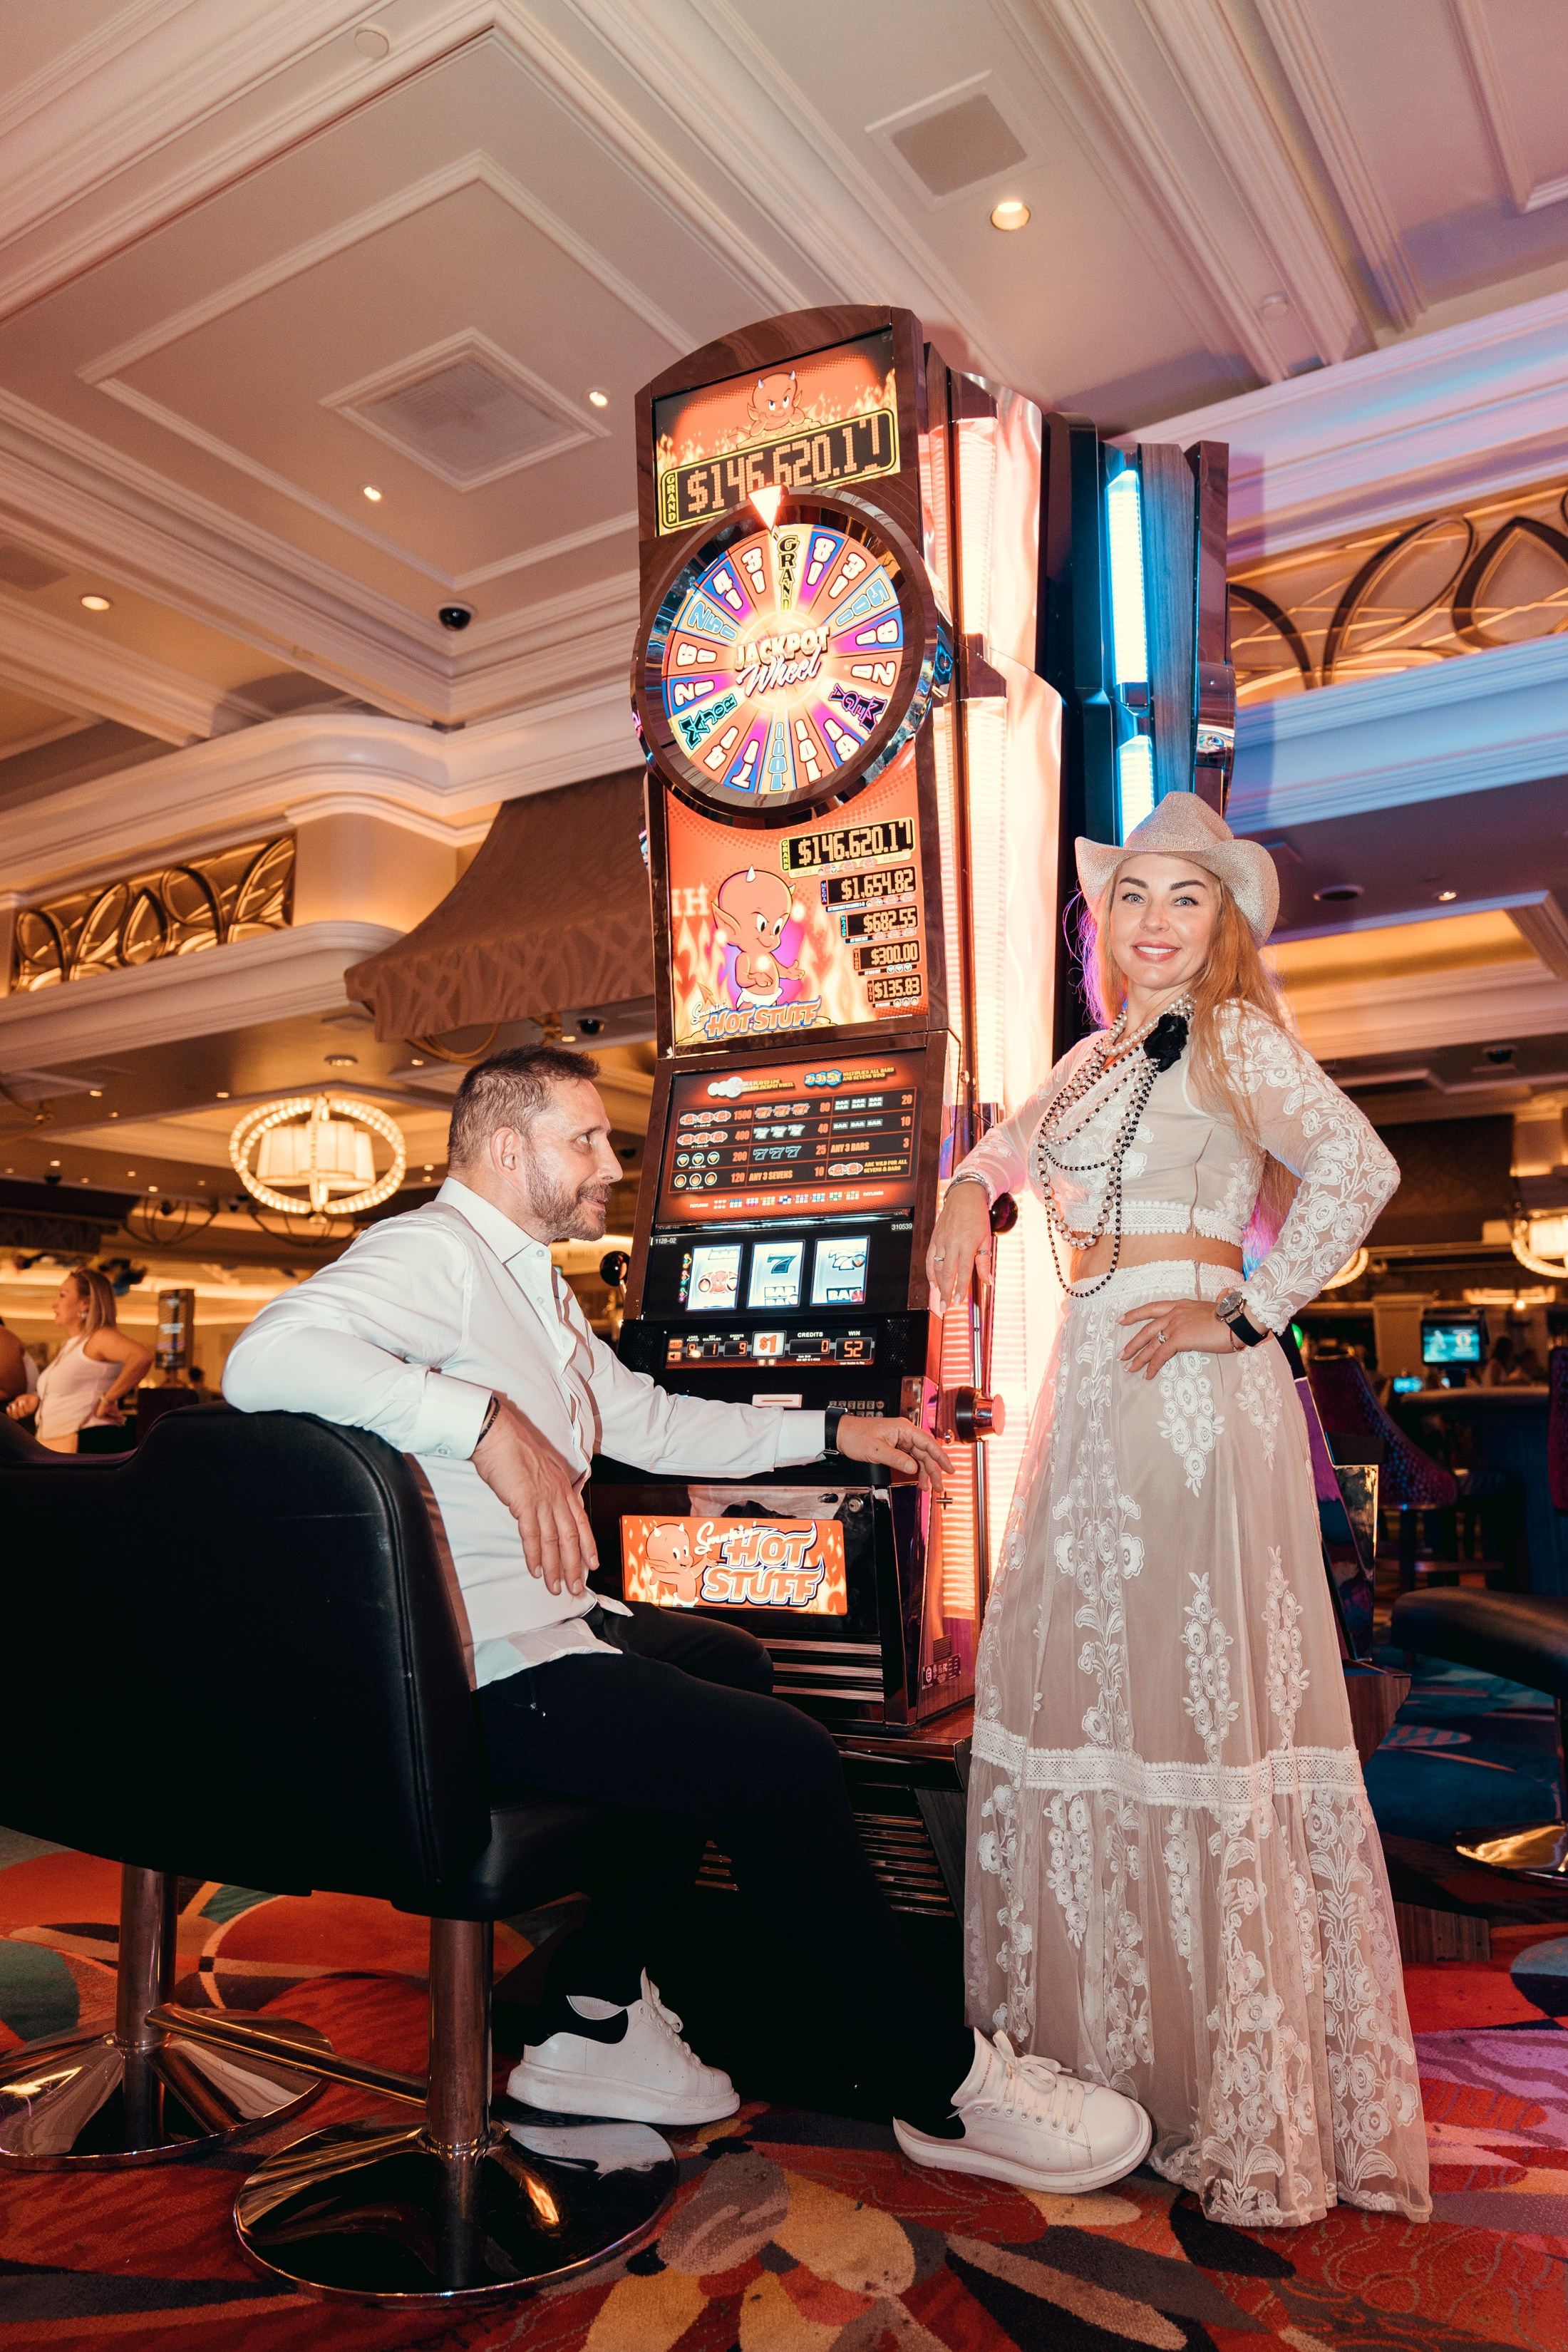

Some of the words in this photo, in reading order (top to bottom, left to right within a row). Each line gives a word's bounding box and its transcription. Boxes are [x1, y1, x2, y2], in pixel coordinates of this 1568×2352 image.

[666, 475, 676, 522] GRAND
[741, 547, 766, 594] 30
[807, 536, 837, 586] 80
[777, 535, 800, 614] GRAND
[828, 552, 867, 599] 30
[712, 567, 743, 610] 40
[836, 579, 890, 626] 500
[688, 601, 737, 641] 250
[735, 625, 829, 672] JACKPOT
[736, 644, 821, 697] Wheel
[852, 661, 896, 686] 20
[674, 679, 715, 706] 20
[829, 684, 887, 733] MEGA
[679, 693, 738, 750] MAJOR
[730, 739, 760, 788] 70
[768, 722, 788, 791] 1000
[795, 719, 822, 783] 100
[864, 907, 917, 933] $682.55
[871, 943, 918, 965] $300.00
[875, 977, 919, 999] $135.83
[705, 1005, 755, 1039] HOT
[753, 996, 822, 1032] STUFF
[820, 1102, 830, 1112] 80
[902, 1095, 912, 1105] 20
[734, 1110, 752, 1120] 1500
[901, 1116, 911, 1126] 10
[735, 1130, 750, 1140] 400
[817, 1123, 828, 1133] 40
[815, 1145, 826, 1155] 25
[830, 1144, 845, 1152] ANY
[845, 1143, 850, 1152] 3
[850, 1142, 870, 1151] BARS
[903, 1138, 909, 1147] 3
[732, 1151, 748, 1162] 200
[731, 1172, 746, 1183] 120
[748, 1172, 763, 1181] ANY
[763, 1172, 768, 1180] 3
[768, 1170, 793, 1180] SEVENS
[815, 1166, 825, 1176] 10
[767, 1254, 797, 1274] 7
[739, 1342, 747, 1354] 9
[760, 1335, 778, 1353] $1
[821, 1340, 829, 1353] 0
[844, 1341, 863, 1357] 52
[693, 1520, 758, 1555] Smokin'
[721, 1520, 817, 1567] HOT
[701, 1552, 825, 1606] STUFF
